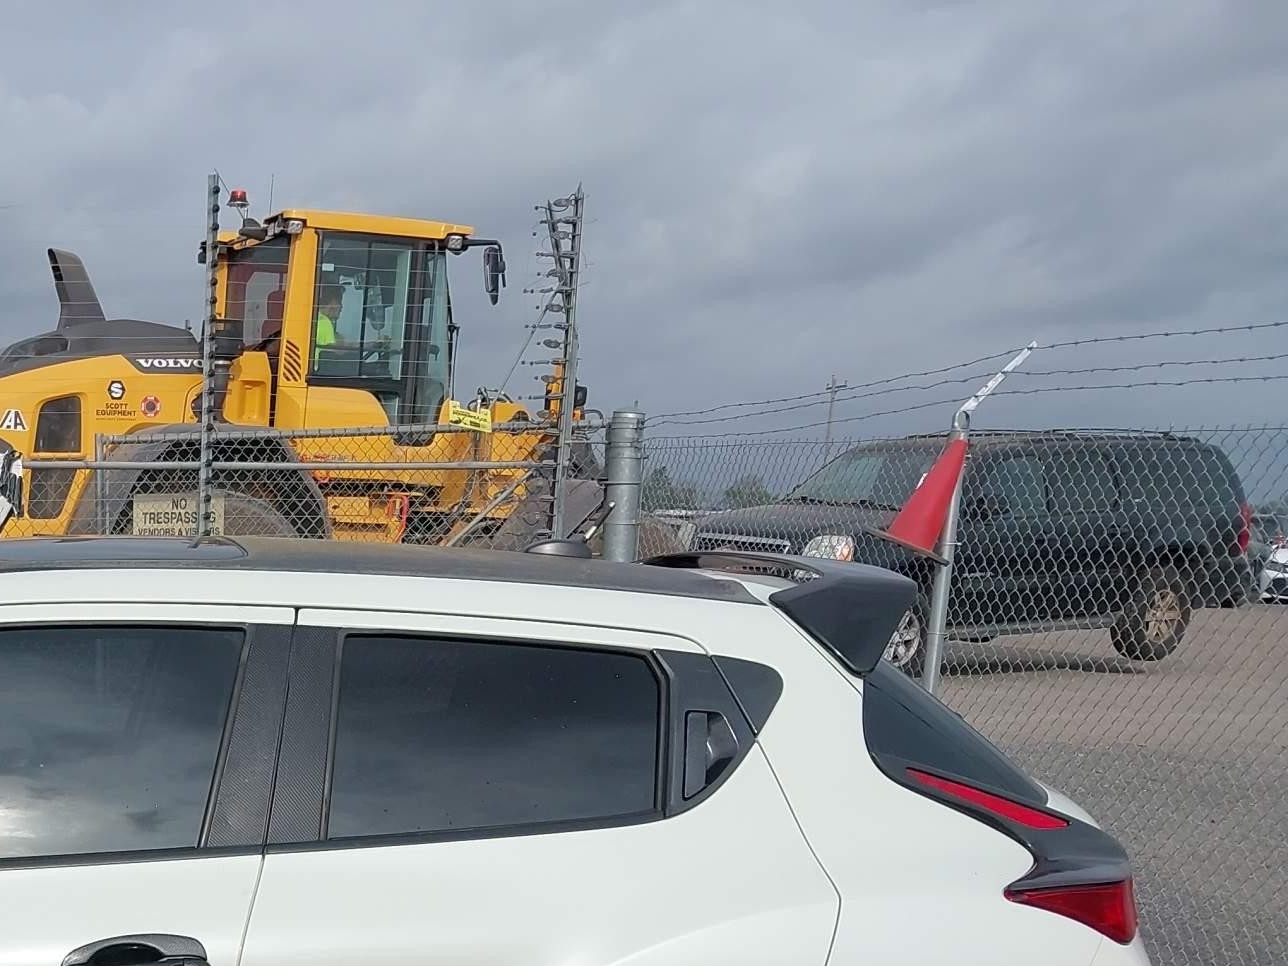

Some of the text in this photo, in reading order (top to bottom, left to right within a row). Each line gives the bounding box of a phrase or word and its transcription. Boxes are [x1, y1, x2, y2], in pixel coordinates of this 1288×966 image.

[135, 358, 205, 368] VOLVO
[105, 402, 128, 410] SCOTT
[96, 409, 137, 417] EQUIPMENT
[171, 498, 187, 510] NO
[138, 527, 176, 536] VENDORS
